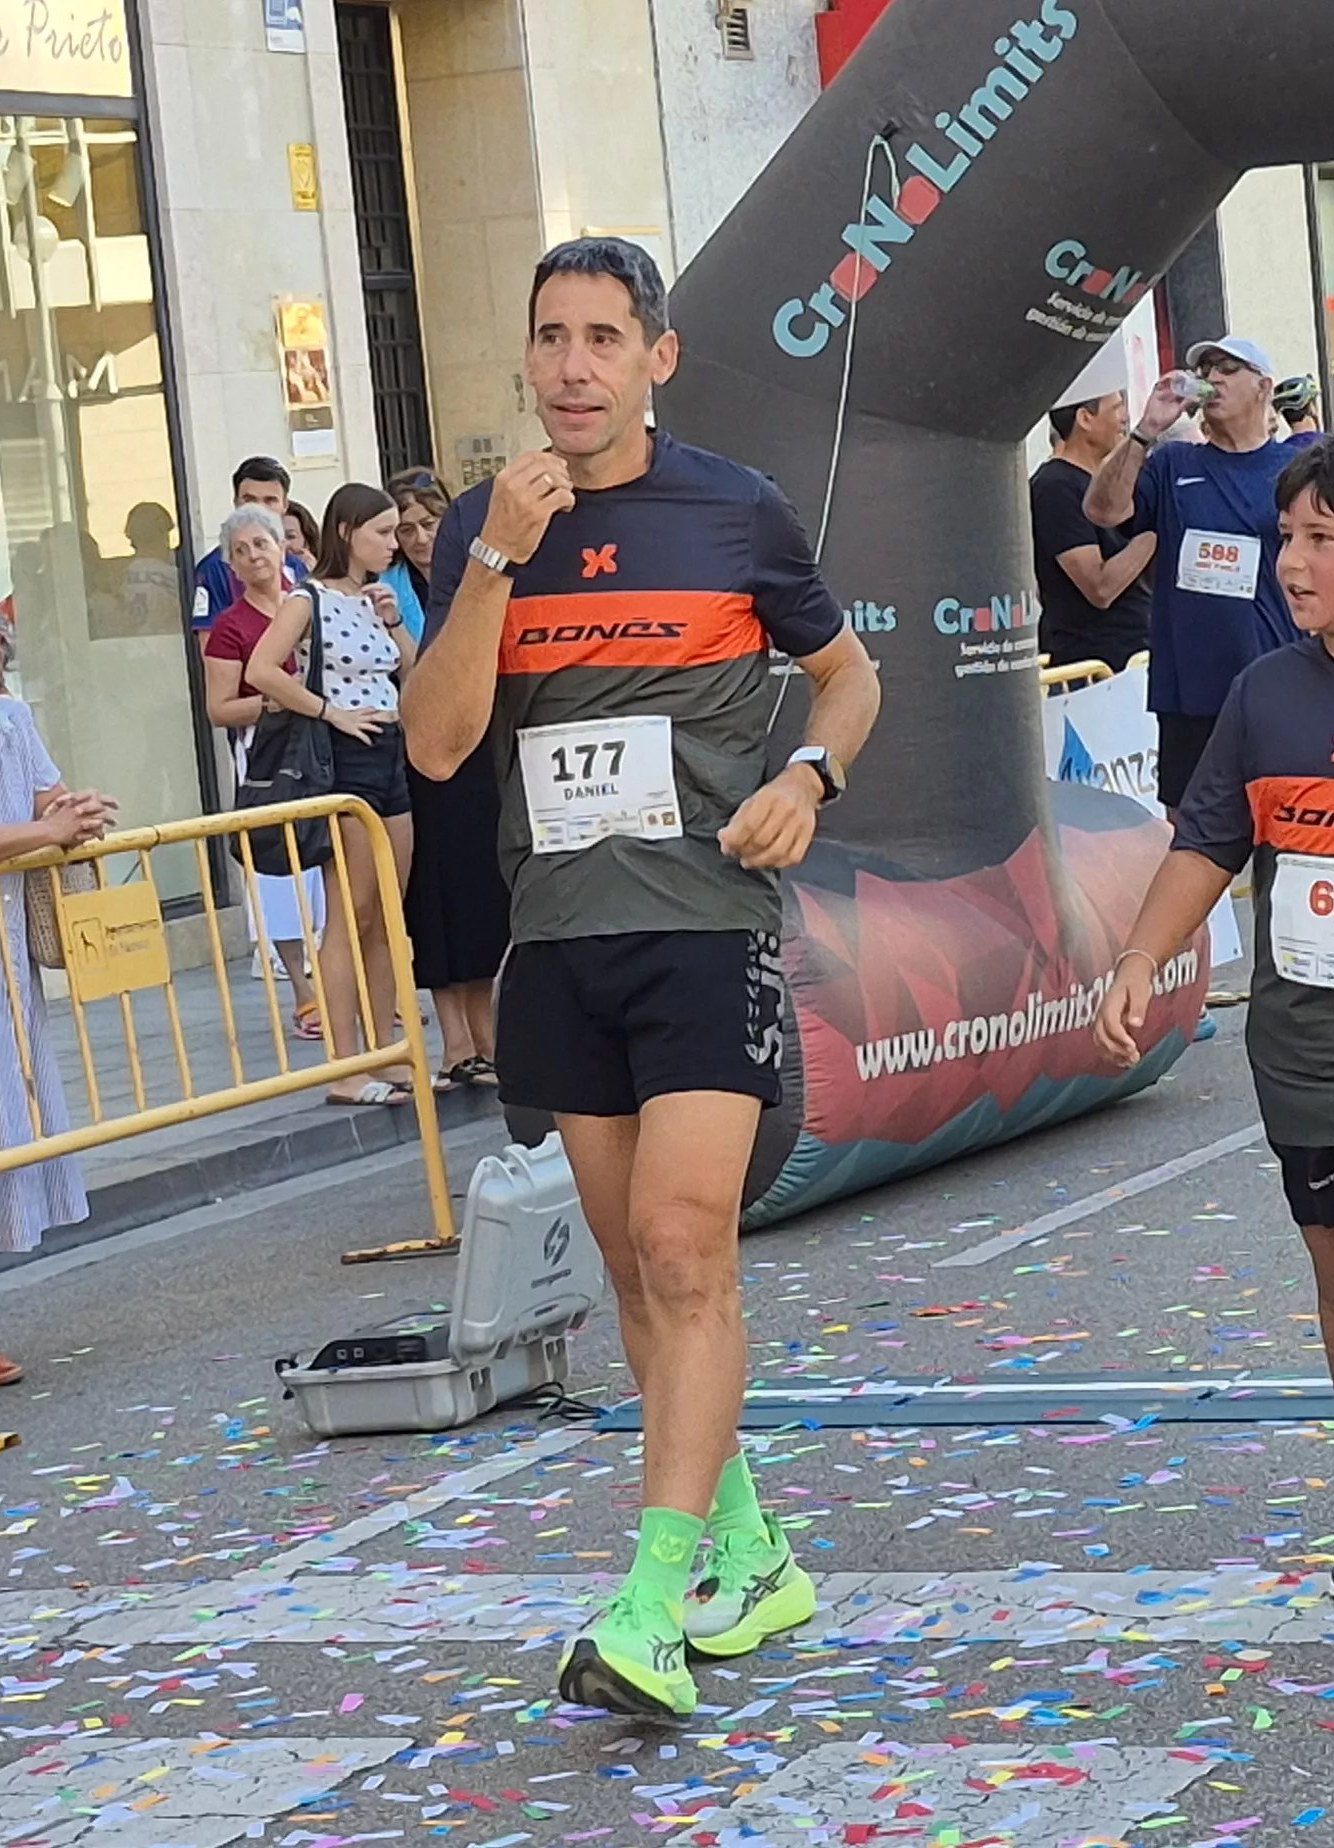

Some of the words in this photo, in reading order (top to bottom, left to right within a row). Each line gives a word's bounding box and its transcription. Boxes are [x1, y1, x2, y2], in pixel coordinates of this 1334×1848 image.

[24, 0, 122, 63] Prieto
[551, 740, 626, 783] 177
[564, 783, 619, 800] DANIEL
